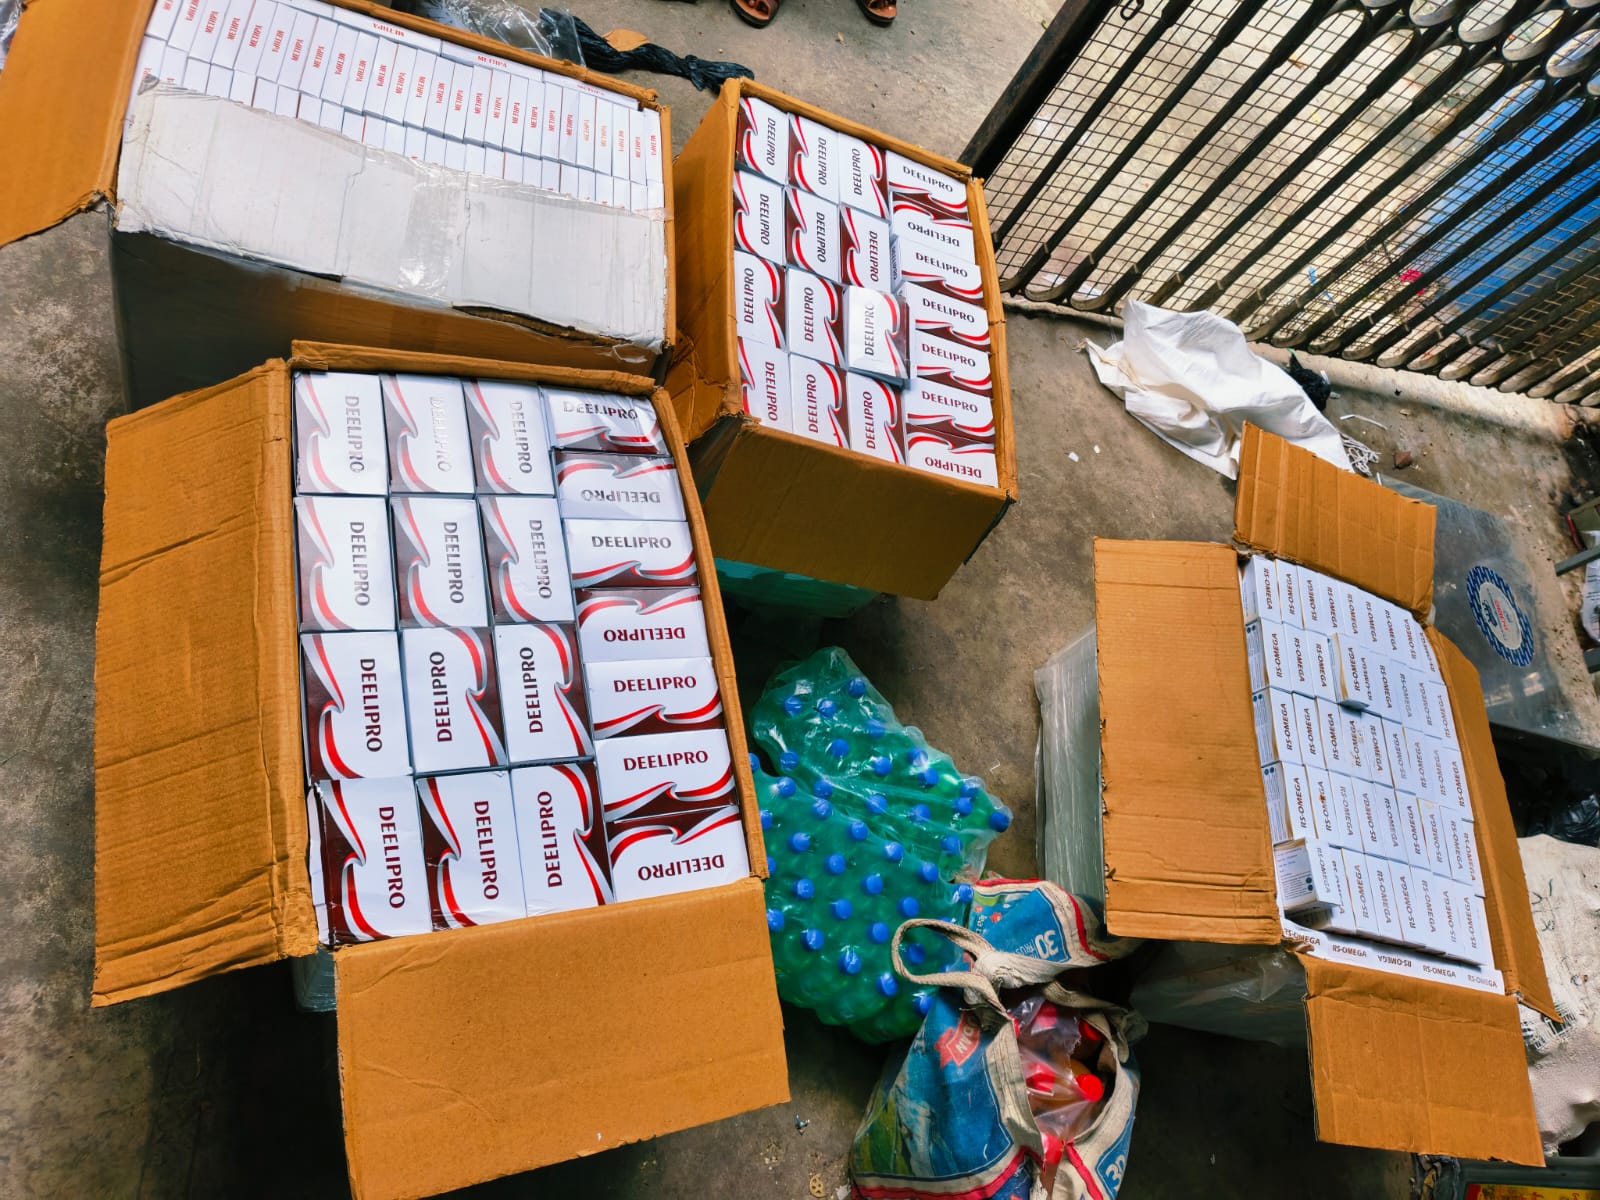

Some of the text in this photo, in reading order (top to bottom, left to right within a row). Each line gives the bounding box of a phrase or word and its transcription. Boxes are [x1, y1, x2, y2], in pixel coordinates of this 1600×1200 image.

[766, 118, 776, 166] DEELIPRO
[818, 137, 827, 185] DEELIPRO
[851, 148, 862, 196] DEELIPRO
[902, 166, 954, 192] DEELIPRO
[760, 194, 770, 246] DEELIPRO
[816, 212, 827, 263] DEELIPRO
[908, 222, 960, 247] DEELIPRO
[869, 231, 879, 282] DEELIPRO
[915, 252, 968, 278] DEELIPRO
[744, 268, 755, 324] DEELIPRO
[804, 287, 814, 342] DEELIPRO
[922, 298, 975, 323] DEELIPRO
[864, 303, 875, 356] DEELIPRO
[922, 344, 976, 367] DEELIPRO
[563, 400, 638, 420] DEELIPRO
[765, 362, 778, 421] DEELIPRO
[806, 374, 818, 433] DEELIPRO
[922, 390, 978, 413] DEELIPRO
[345, 395, 364, 473] DEELIPRO
[510, 401, 532, 474] DEELIPRO
[862, 392, 876, 449] DEELIPRO
[925, 456, 982, 478] DEELIPRO
[581, 488, 660, 504] DEELIPRO
[350, 522, 370, 606] DEELIPRO
[444, 522, 464, 604] DEELIPRO
[529, 520, 552, 599] DEELIPRO
[591, 535, 672, 549] DEELIPRO
[1264, 568, 1273, 610] RS-OMEGA
[1286, 573, 1295, 615] RS-OMEGA
[1307, 579, 1318, 621] RS-OMEGA
[1327, 587, 1338, 628] RS-OMEGA
[603, 627, 686, 642] DEELIPRO
[1347, 593, 1358, 634] RS-OMEGA
[1365, 601, 1378, 642] RS-OMEGA
[1385, 609, 1397, 651] RS-OMEGA
[1272, 633, 1283, 678] RS-OMEGA
[1294, 637, 1305, 682] RS-OMEGA
[1404, 619, 1416, 660] RS-OMEGA
[614, 676, 697, 692] DEELIPRO
[1316, 643, 1327, 688] RS-OMEGA
[1348, 647, 1360, 691] RS-OMEGA
[1361, 657, 1373, 701] RS-OMEGA
[1380, 664, 1392, 709] RS-OMEGA
[360, 658, 382, 752] DEELIPRO
[429, 651, 453, 742] DEELIPRO
[519, 647, 543, 733] DEELIPRO
[1400, 673, 1412, 718] RS-OMEGA
[1420, 682, 1432, 726] RS-OMEGA
[1280, 704, 1292, 750] RS-OMEGA
[1304, 708, 1316, 755] RS-OMEGA
[1328, 713, 1339, 760] RS-OMEGA
[1437, 695, 1451, 738] RS-OMEGA
[624, 750, 708, 770] DEELIPRO
[1350, 720, 1361, 767] RS-OMEGA
[1370, 725, 1383, 772] RS-OMEGA
[1393, 733, 1407, 780] RS-OMEGA
[1414, 742, 1427, 788] RS-OMEGA
[1433, 750, 1446, 796] RS-OMEGA
[1452, 761, 1465, 807] RS-OMEGA
[1294, 778, 1307, 828] RS-OMEGA
[1340, 786, 1354, 836] RS-OMEGA
[1362, 793, 1377, 842] RS-OMEGA
[1384, 798, 1399, 848] RS-OMEGA
[474, 801, 500, 900] DEELIPRO
[537, 791, 562, 888] DEELIPRO
[1407, 805, 1421, 855] RS-OMEGA
[1429, 813, 1442, 863] RS-OMEGA
[1451, 821, 1463, 870] RS-OMEGA
[379, 806, 406, 908] DEELIPRO
[638, 854, 724, 880] DEELIPRO
[1464, 832, 1476, 881] RS-OMEGA
[1354, 864, 1369, 918] RS-OMEGA
[1377, 870, 1392, 924] RS-OMEGA
[1400, 876, 1416, 929] RS-OMEGA
[1422, 880, 1437, 933] RS-OMEGA
[1443, 890, 1456, 942] RS-OMEGA
[1464, 897, 1477, 949] RS-OMEGA
[1035, 930, 1058, 959] 30
[1332, 944, 1367, 958] RS-OMEGA
[1378, 954, 1412, 968] RS-OMEGA
[1422, 965, 1456, 978] RS-OMEGA
[1468, 974, 1498, 988] RS-OMEGA
